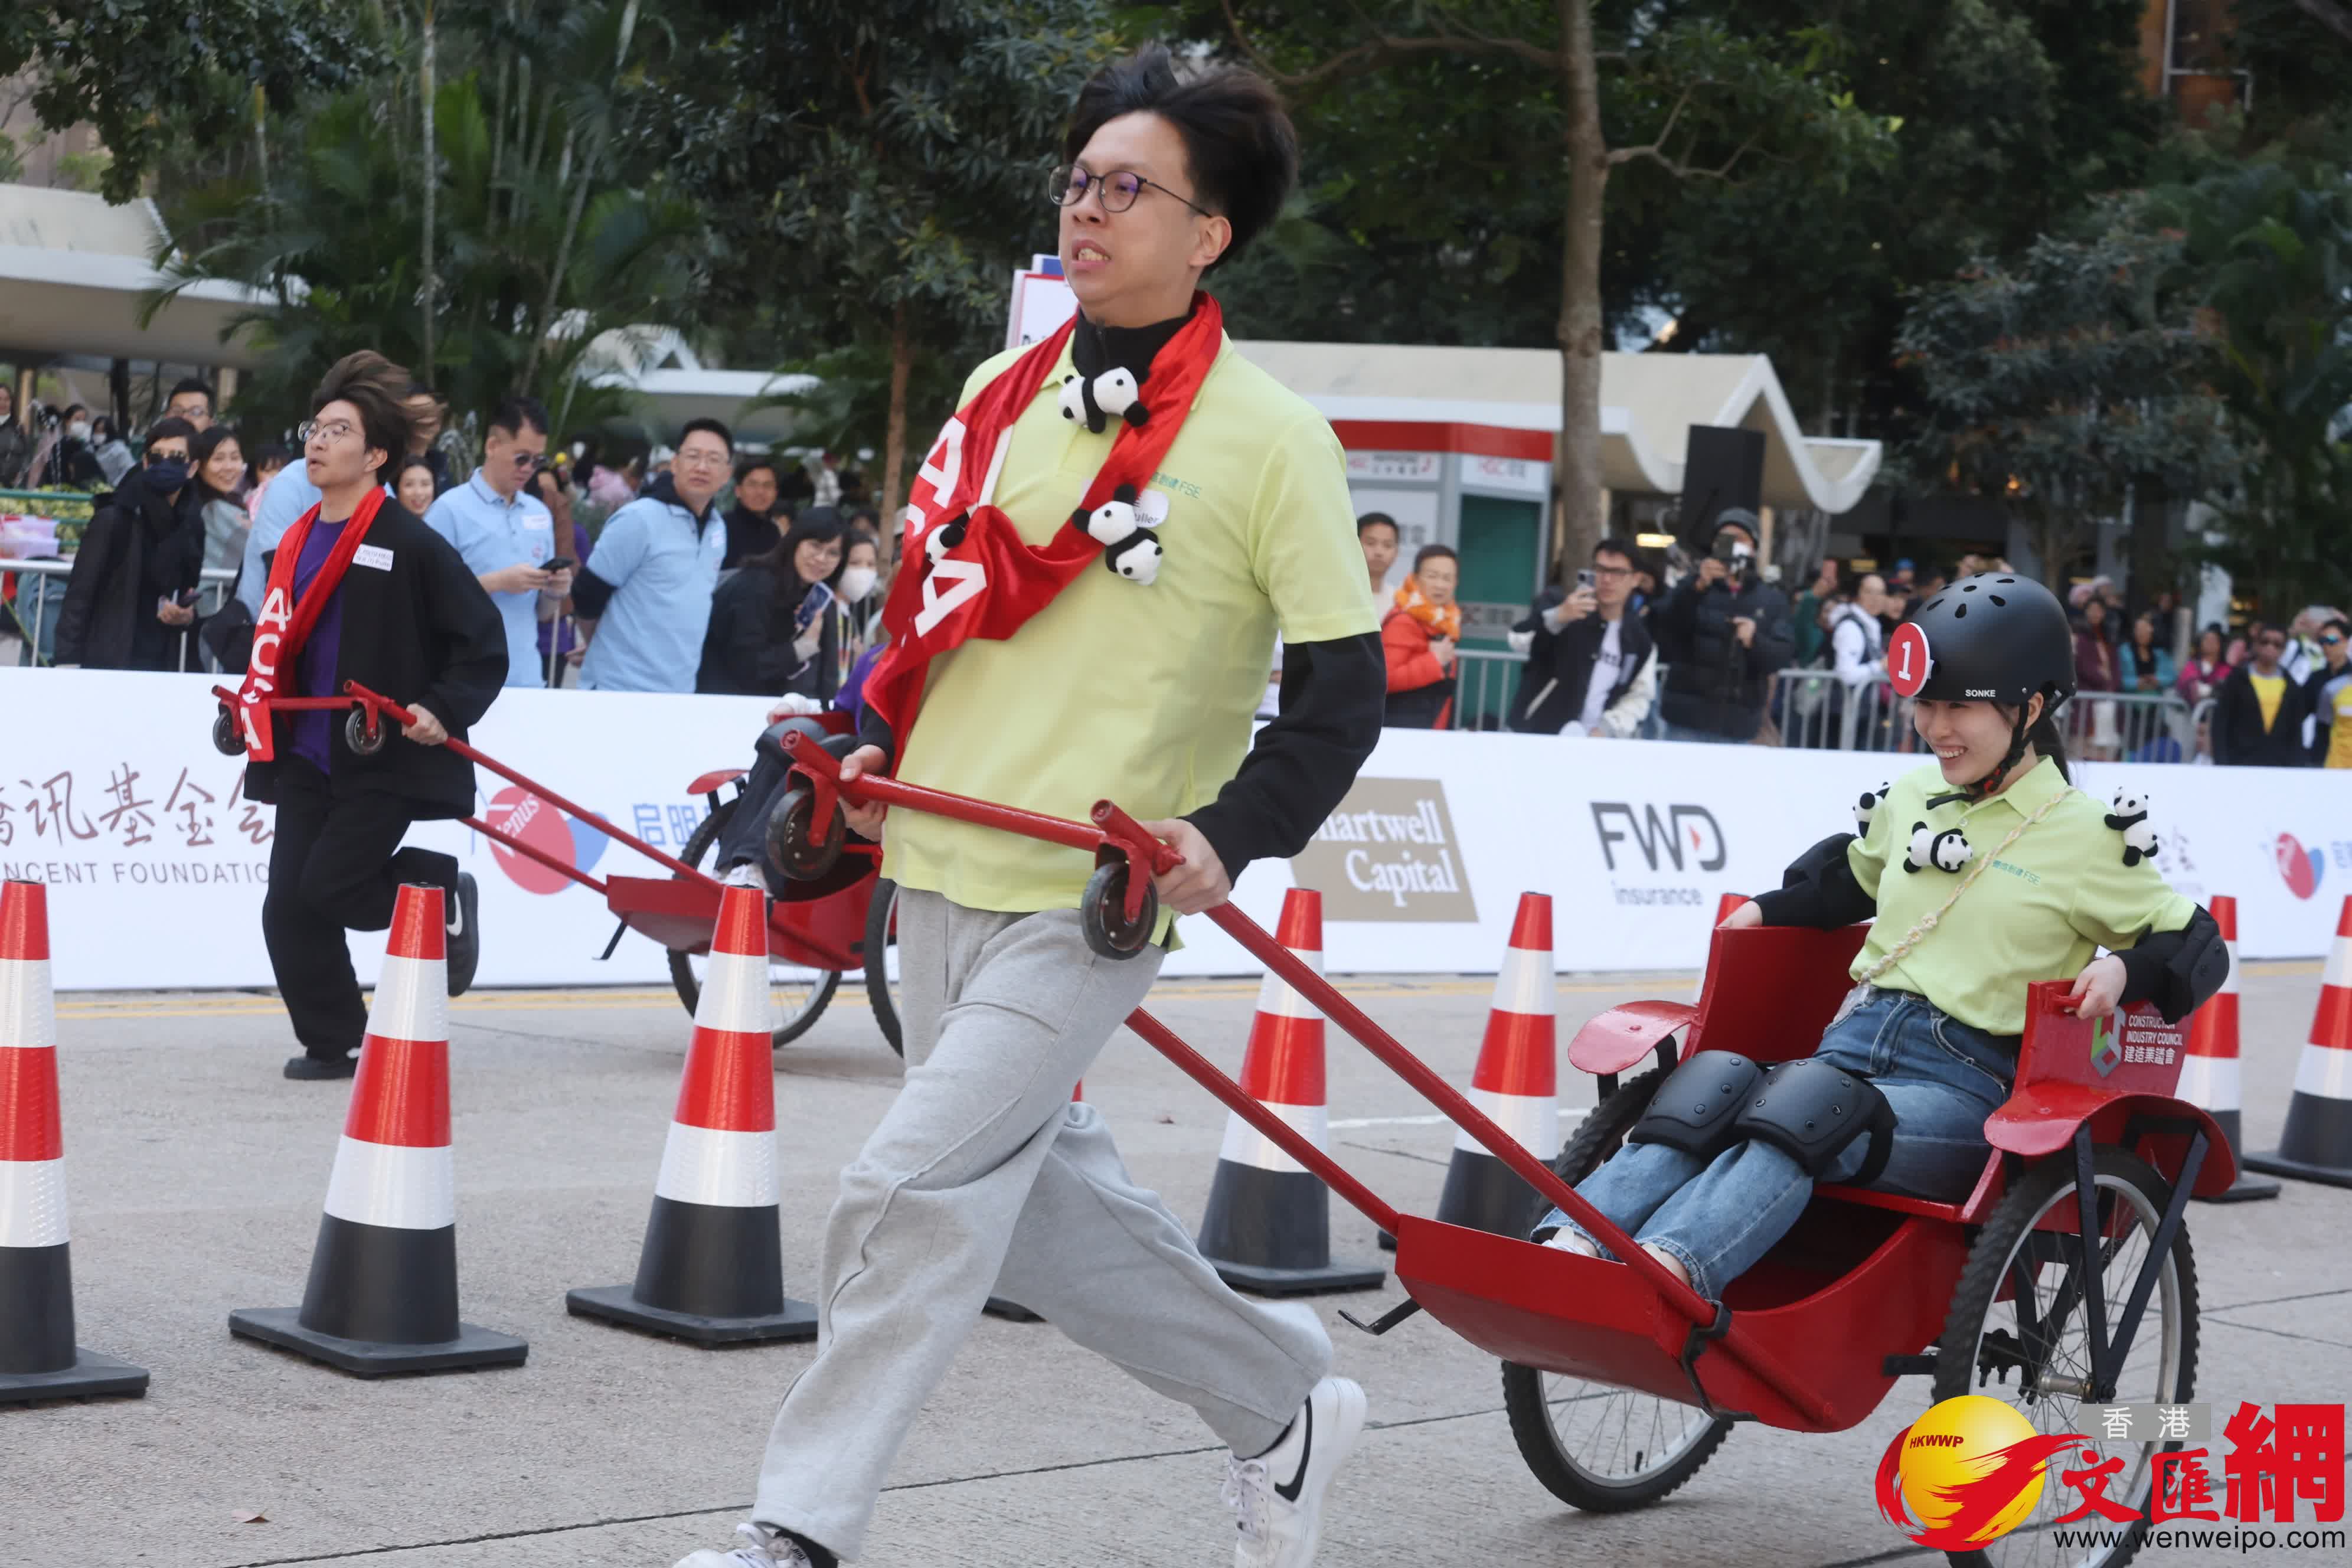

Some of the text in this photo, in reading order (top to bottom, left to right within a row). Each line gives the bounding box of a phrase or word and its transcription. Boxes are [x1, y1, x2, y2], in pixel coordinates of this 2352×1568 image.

[1134, 512, 1161, 524] uller
[1898, 641, 1912, 681] 1
[1965, 689, 1996, 697] SONKE
[0, 762, 275, 847] 讯基金会
[1590, 802, 1727, 872] FWD
[1345, 848, 1460, 907] Capital
[1611, 880, 1703, 906] insurance
[2126, 1031, 2183, 1046] INDUSTRY COUNCIL
[2124, 1046, 2175, 1065] 建造業議會
